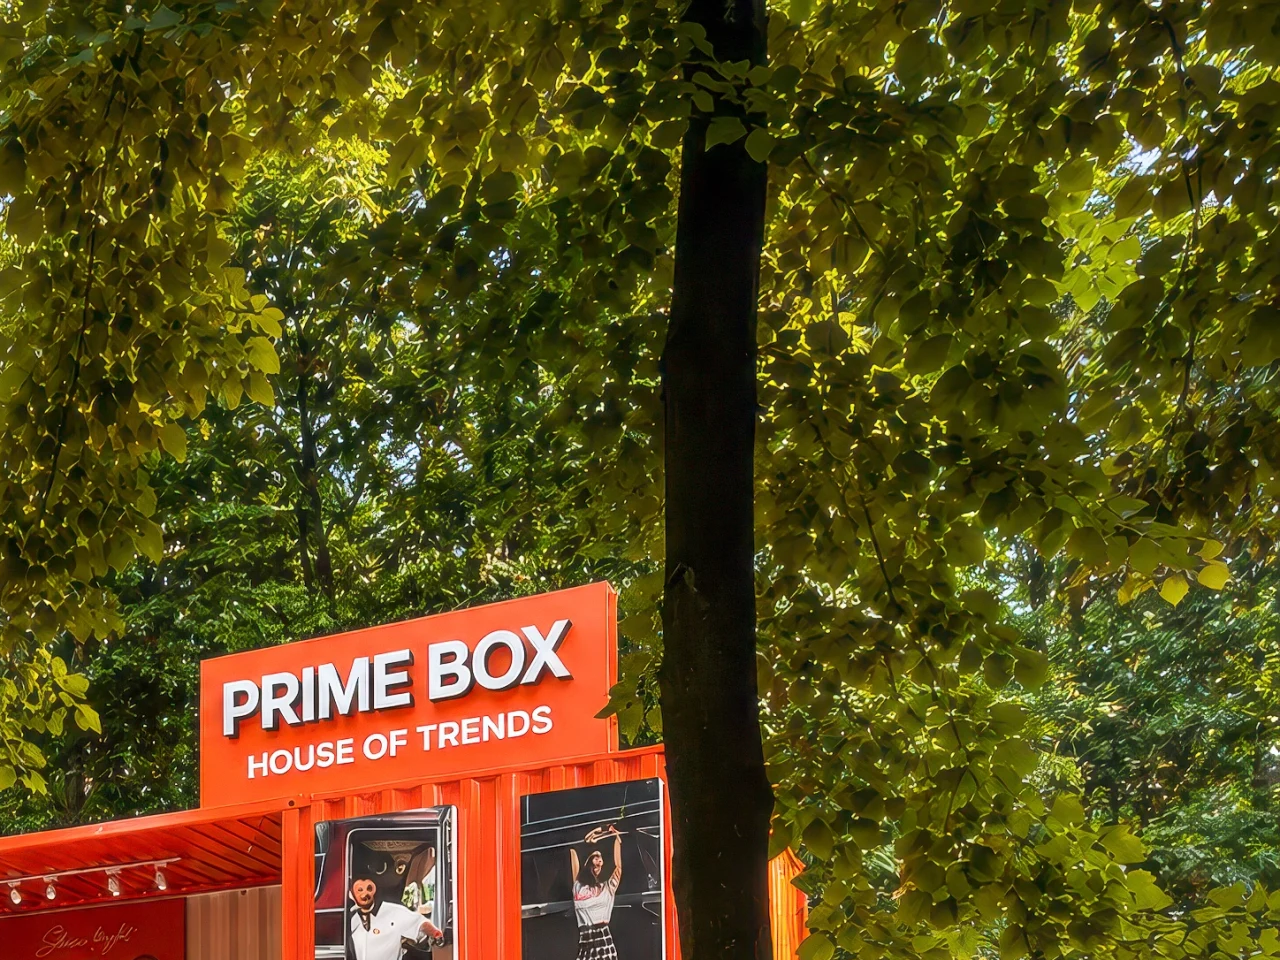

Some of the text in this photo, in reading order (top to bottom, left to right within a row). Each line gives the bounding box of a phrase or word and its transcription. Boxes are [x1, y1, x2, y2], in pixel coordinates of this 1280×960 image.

[222, 619, 575, 738] PRIME BOX
[247, 705, 553, 779] HOUSE OF TRENDS
